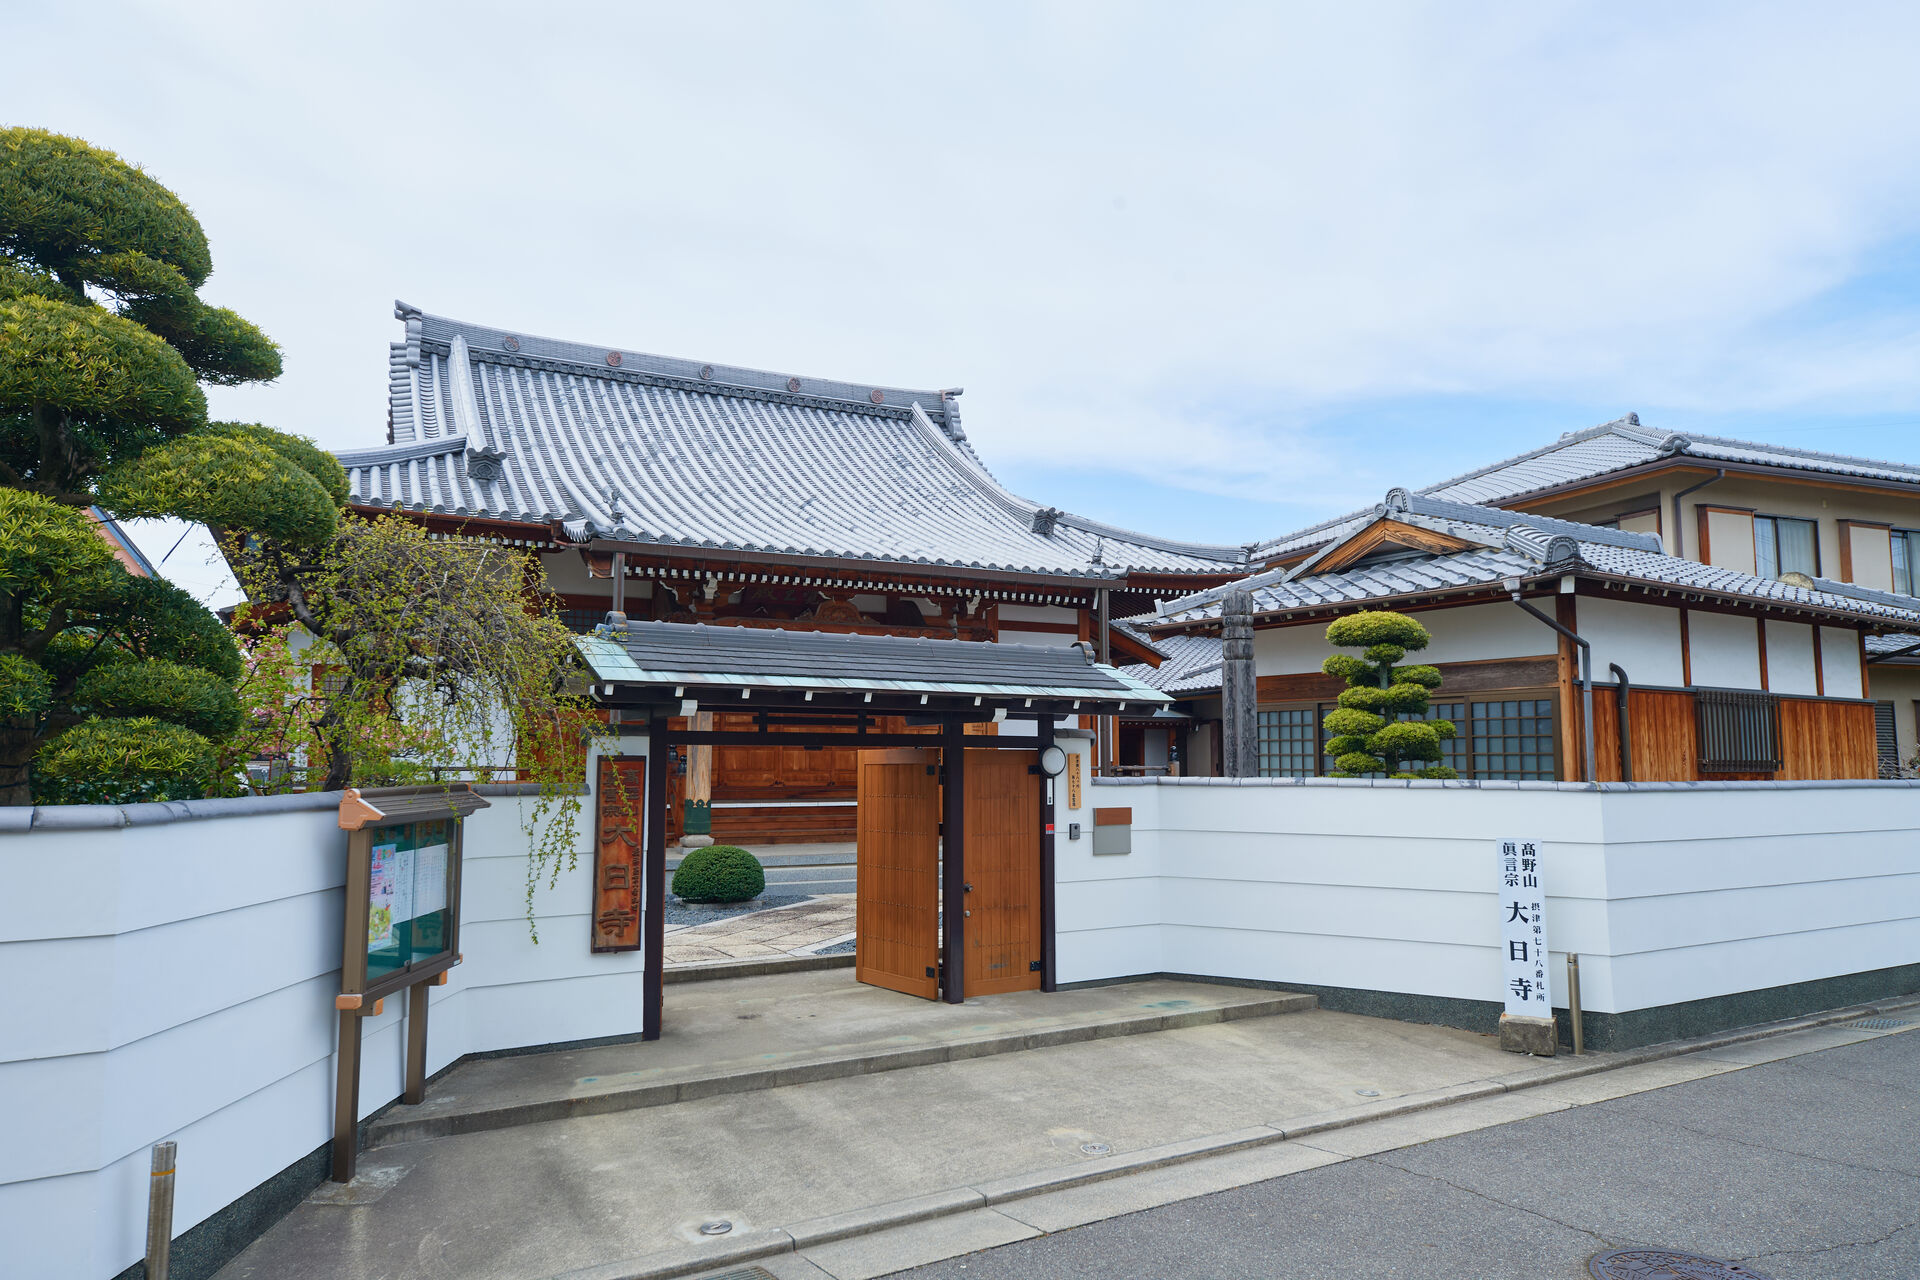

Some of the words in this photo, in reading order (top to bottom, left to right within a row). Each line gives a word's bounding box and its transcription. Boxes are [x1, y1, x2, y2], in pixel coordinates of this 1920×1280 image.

[600, 823, 638, 937] 大日寺
[1505, 901, 1533, 1001] 大日寺
